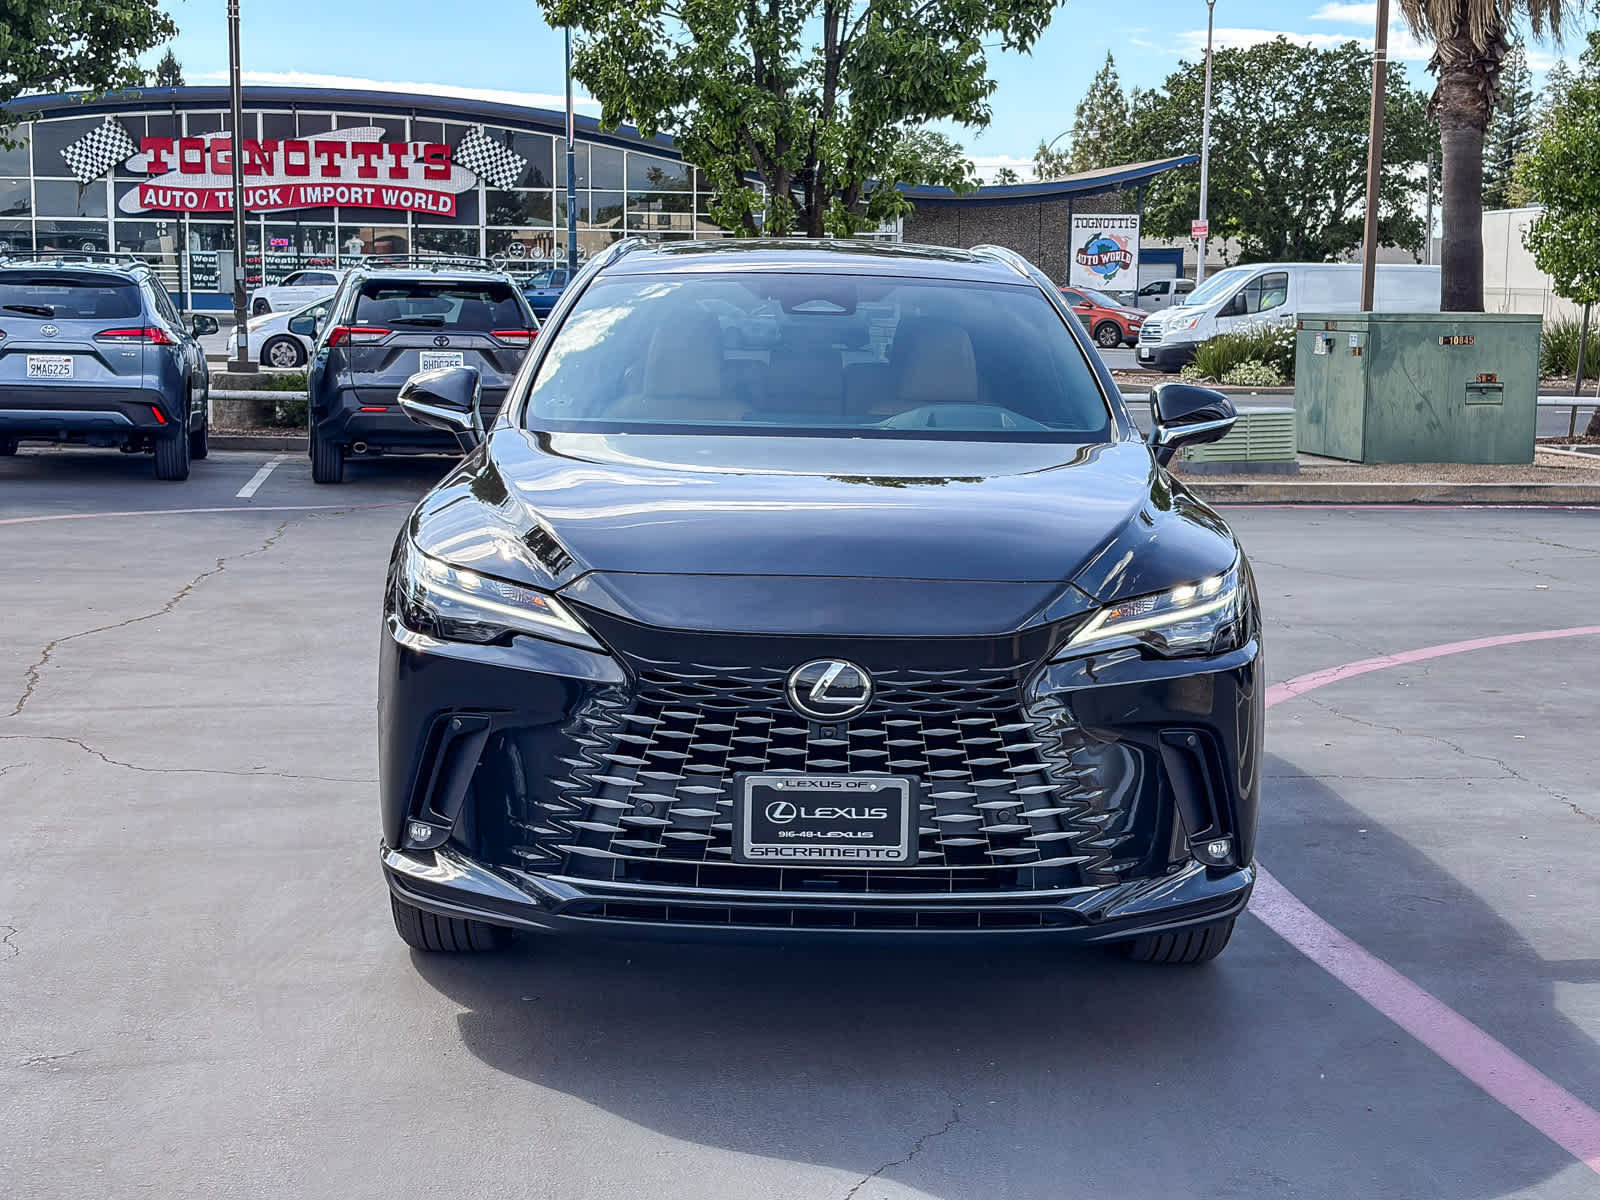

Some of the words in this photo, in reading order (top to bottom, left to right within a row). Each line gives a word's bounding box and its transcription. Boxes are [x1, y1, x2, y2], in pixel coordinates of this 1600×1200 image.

[140, 137, 451, 180] TOGNOTTI'S
[144, 188, 198, 209] AUTO
[300, 186, 375, 204] IMPORT
[382, 188, 452, 213] WORLD
[1074, 216, 1138, 229] TOGNOTTI'S
[1077, 252, 1099, 265] AUTO
[1100, 250, 1132, 264] WORLD
[30, 363, 70, 375] 9MAG225
[785, 780, 842, 788] LEXUS
[845, 781, 869, 789] OF
[801, 807, 888, 819] LEXUS
[750, 847, 901, 858] SACRAMENTO
